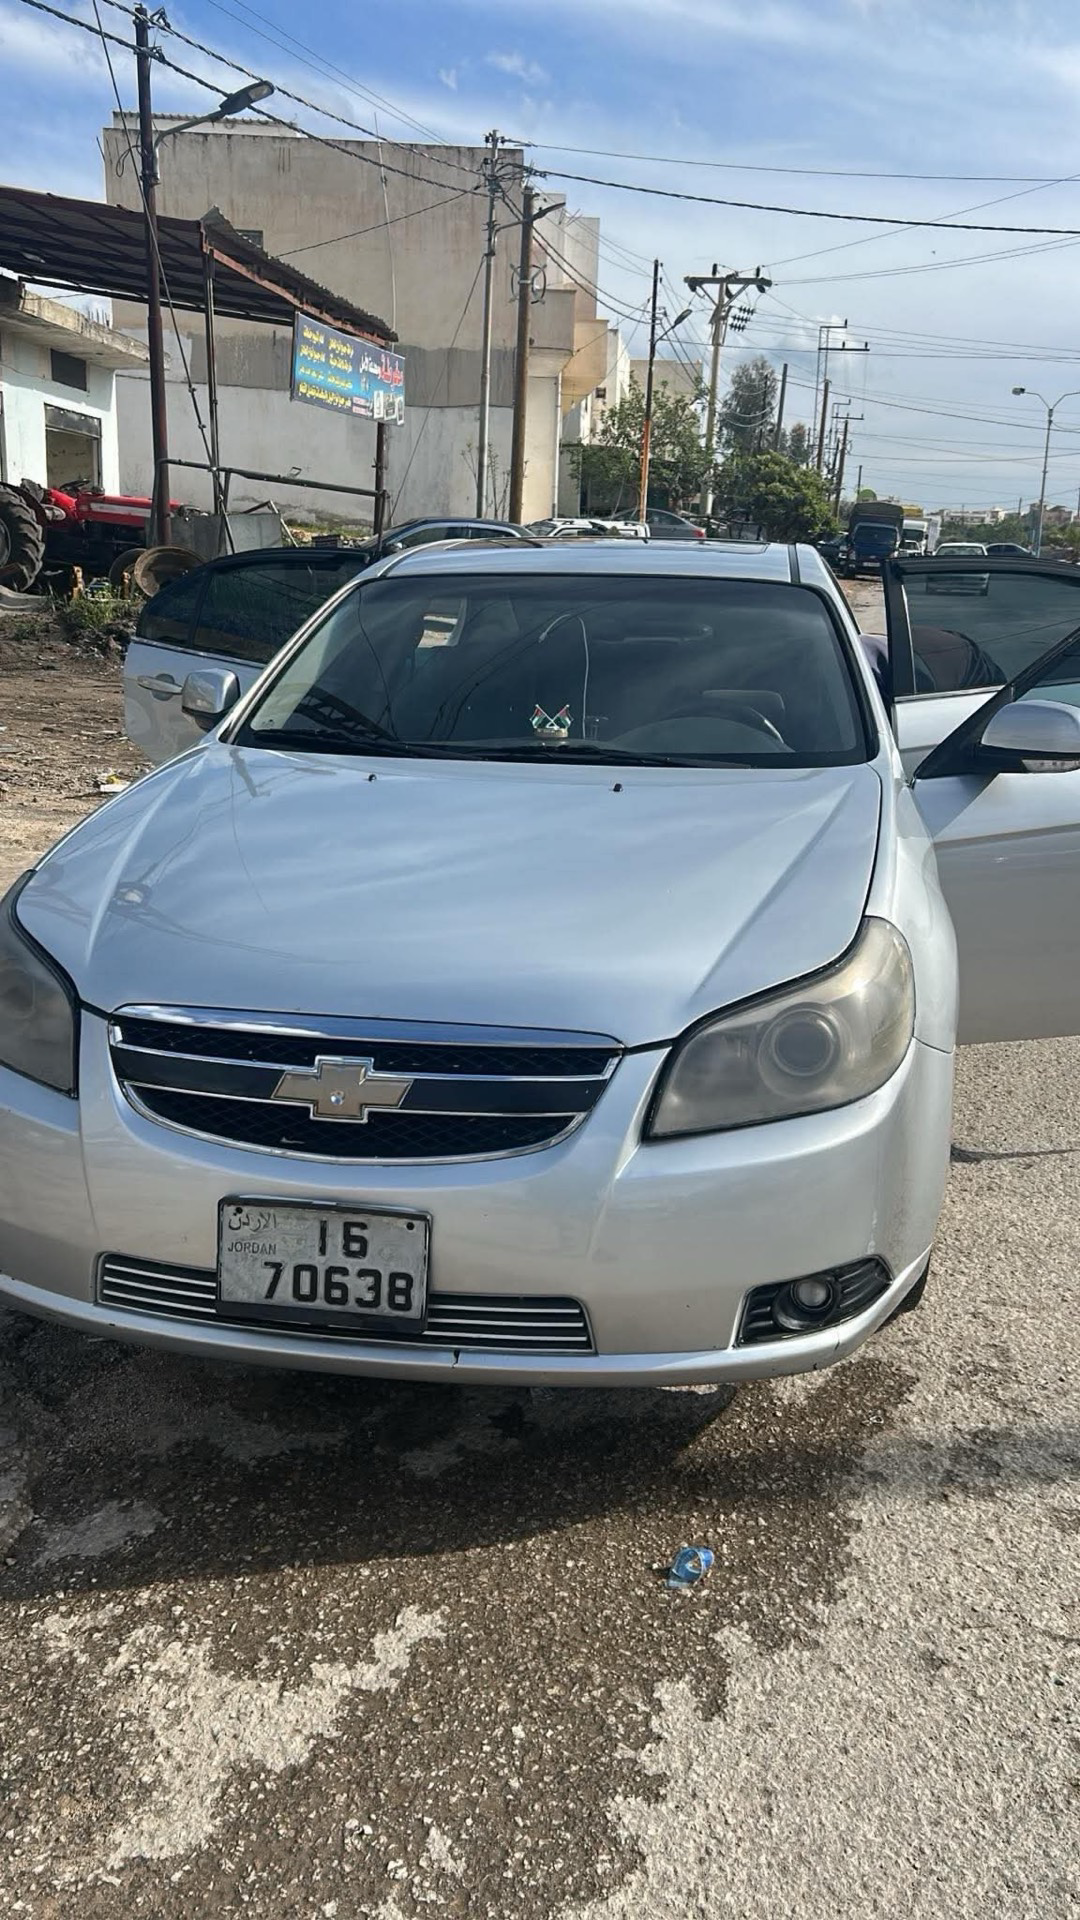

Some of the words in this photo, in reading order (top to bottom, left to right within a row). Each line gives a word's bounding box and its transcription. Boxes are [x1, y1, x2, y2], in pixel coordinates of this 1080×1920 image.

[227, 1241, 276, 1255] JORDAN
[318, 1220, 368, 1259] 16
[263, 1261, 413, 1311] 70638
